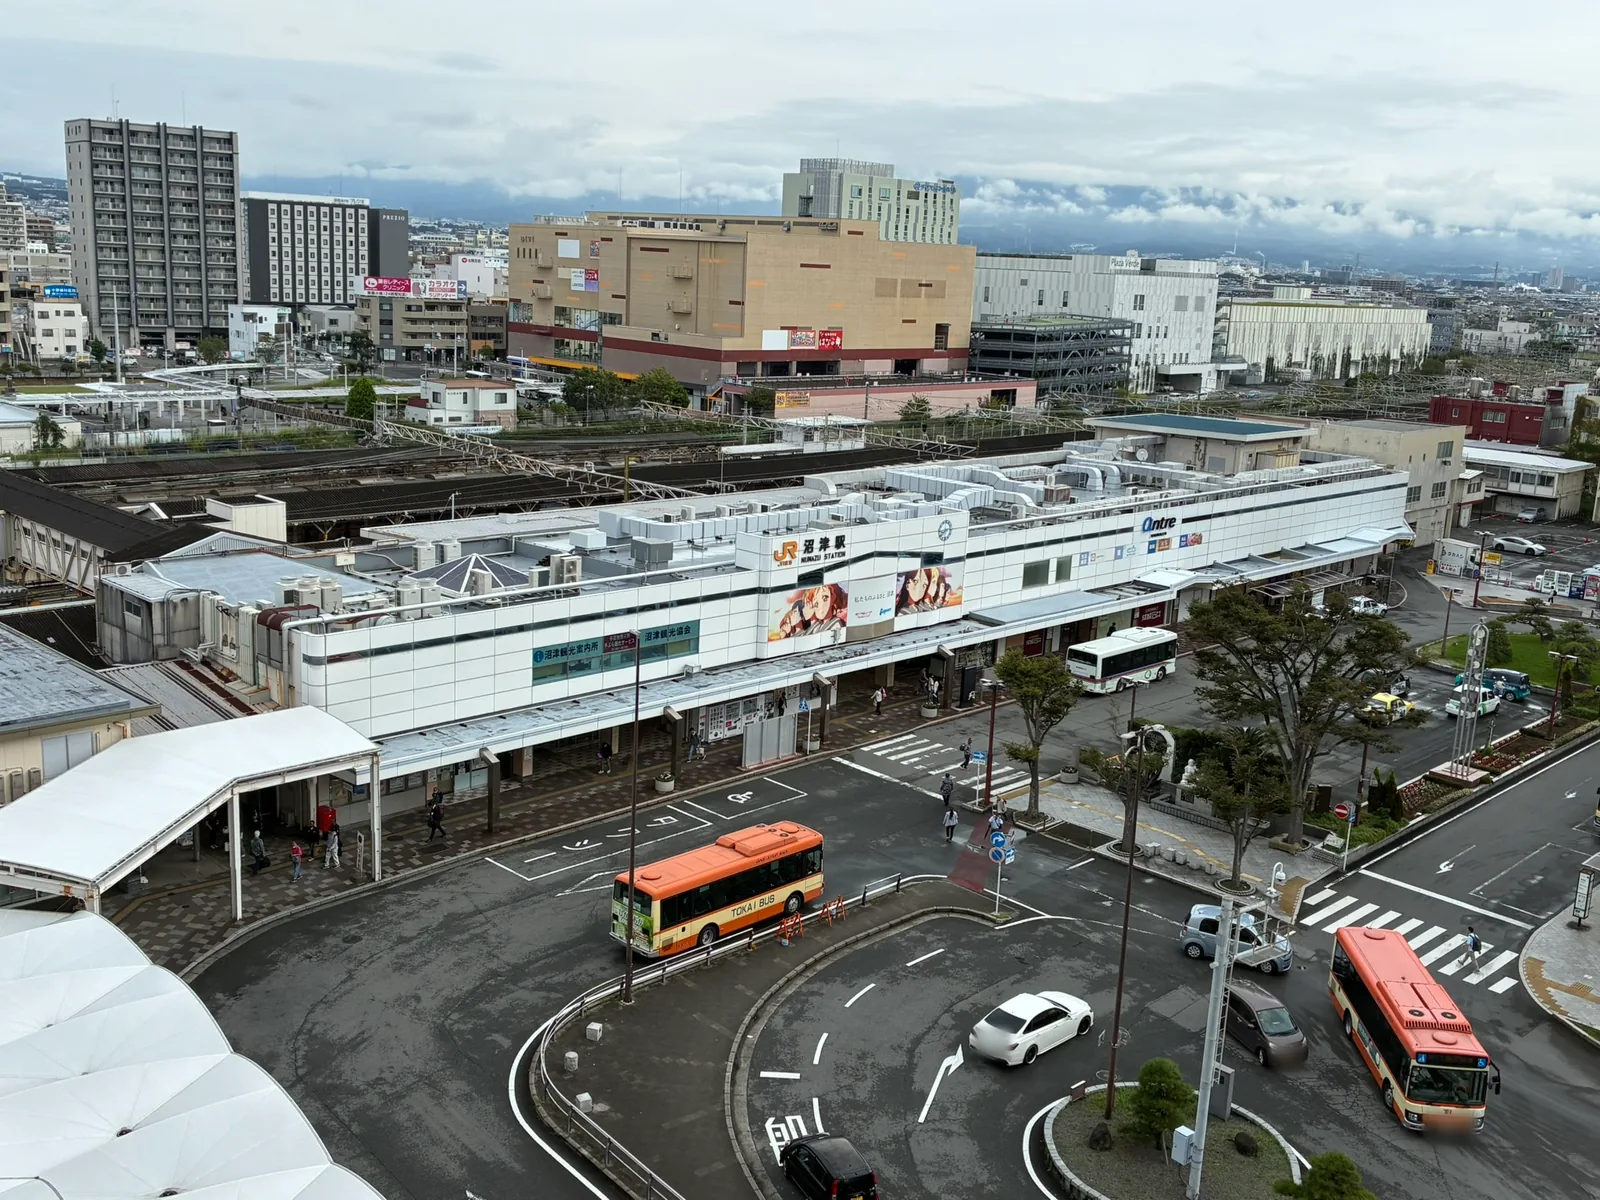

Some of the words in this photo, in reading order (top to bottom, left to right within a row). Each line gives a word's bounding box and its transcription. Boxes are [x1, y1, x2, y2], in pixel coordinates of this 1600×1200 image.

[429, 280, 456, 288] カラオケ
[774, 541, 798, 562] JR
[803, 534, 846, 554] 沼津駅
[801, 554, 821, 563] NUMAZU
[824, 551, 846, 560] STATION
[644, 625, 691, 642] 沼津観光協会
[544, 641, 599, 660] 沼津観光案内所
[731, 903, 757, 918] TOKAI
[759, 894, 775, 907] BUS
